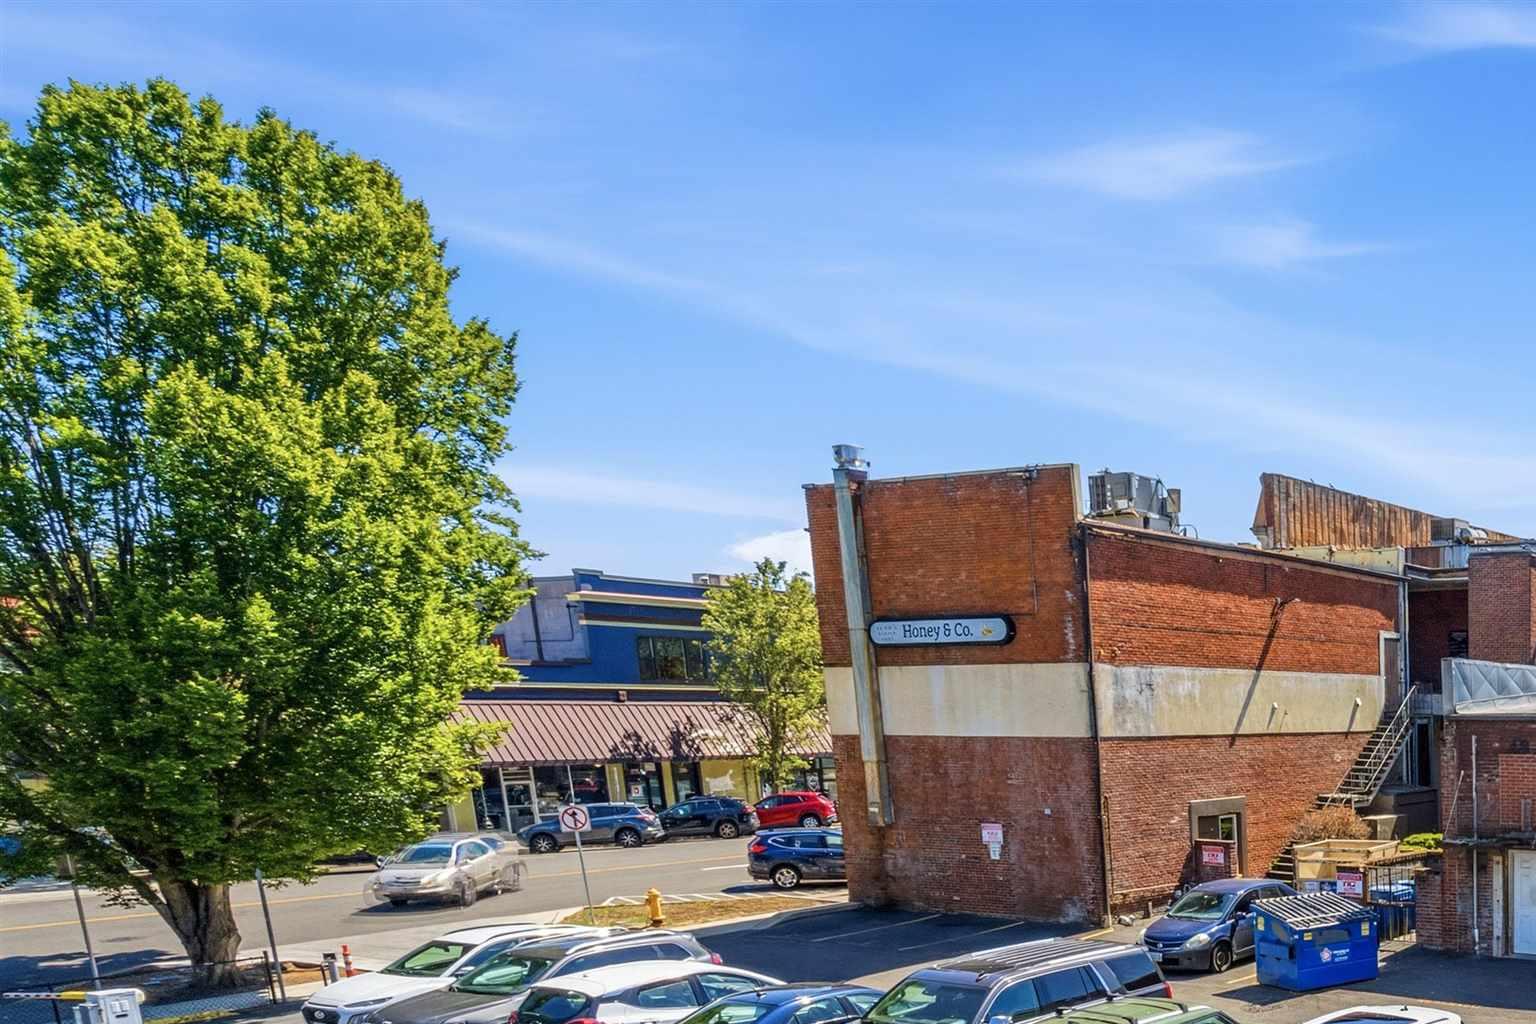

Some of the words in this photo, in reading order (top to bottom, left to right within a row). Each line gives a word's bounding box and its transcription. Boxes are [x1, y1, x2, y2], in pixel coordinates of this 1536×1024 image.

[902, 624, 940, 640] Honey
[943, 623, 952, 637] &
[954, 622, 974, 637] Co.
